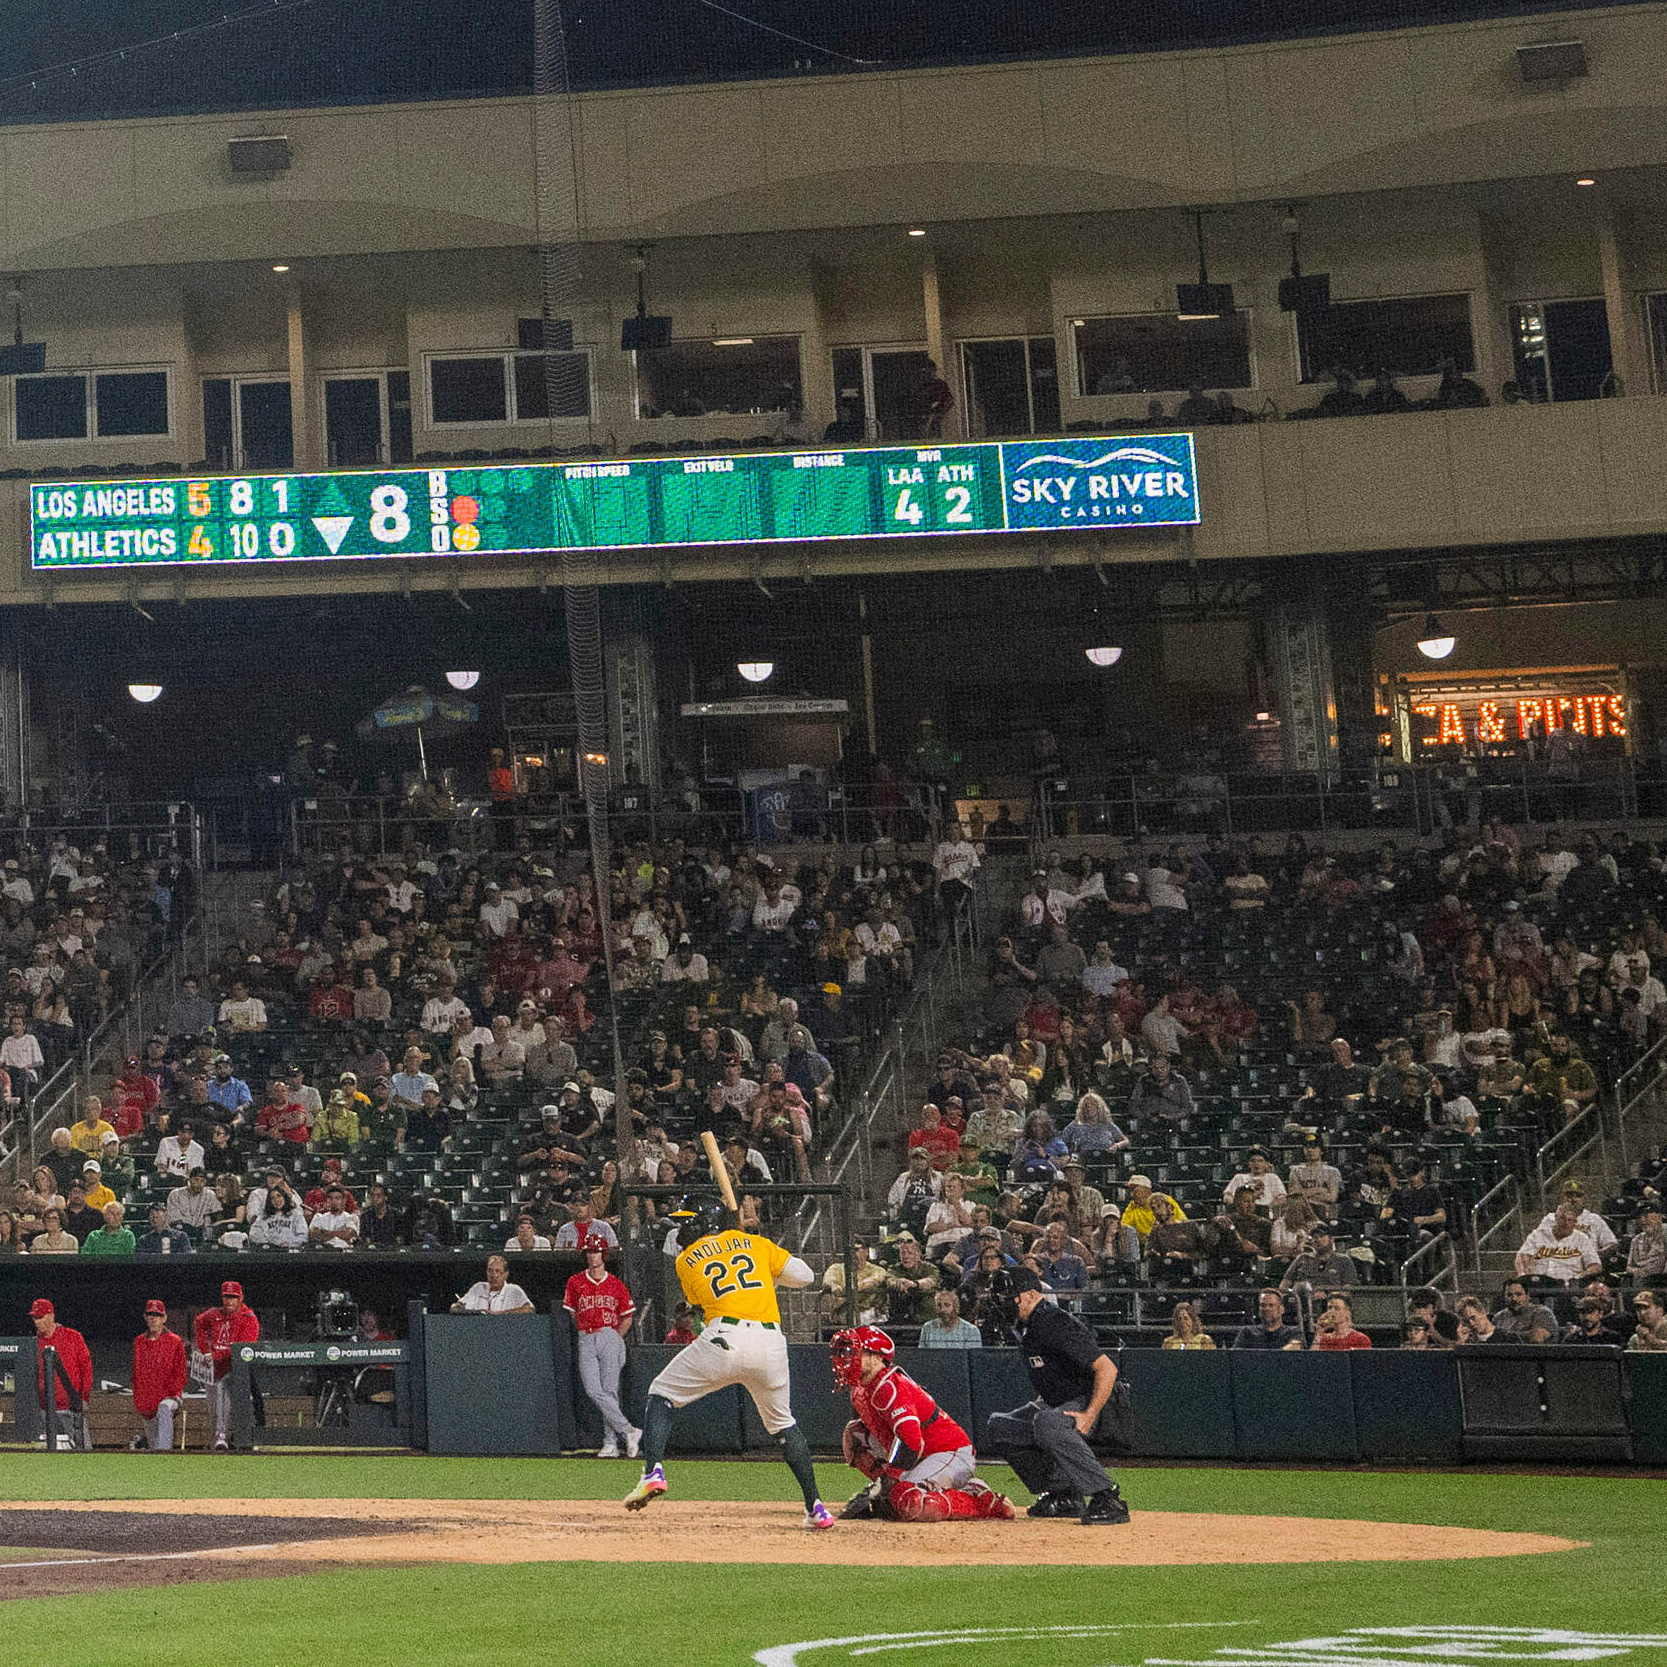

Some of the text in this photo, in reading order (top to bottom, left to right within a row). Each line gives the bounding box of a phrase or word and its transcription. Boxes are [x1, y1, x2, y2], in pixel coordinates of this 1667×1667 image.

[428, 470, 448, 497] B
[887, 465, 974, 485] LAA ATH
[1012, 471, 1190, 504] SKY RIVER
[37, 480, 289, 518] LOS ANGELES 5 8 1
[369, 484, 411, 543] 8
[429, 497, 449, 525] S
[894, 486, 972, 526] 4 2
[1060, 503, 1144, 518] CASINO
[38, 522, 296, 559] ATHLETICS 4 10 0
[685, 1237, 752, 1268] ANDUJAR
[703, 1253, 764, 1300] 22
[255, 1350, 316, 1359] POWER MARKET
[341, 1348, 402, 1357] POWER MARKET
